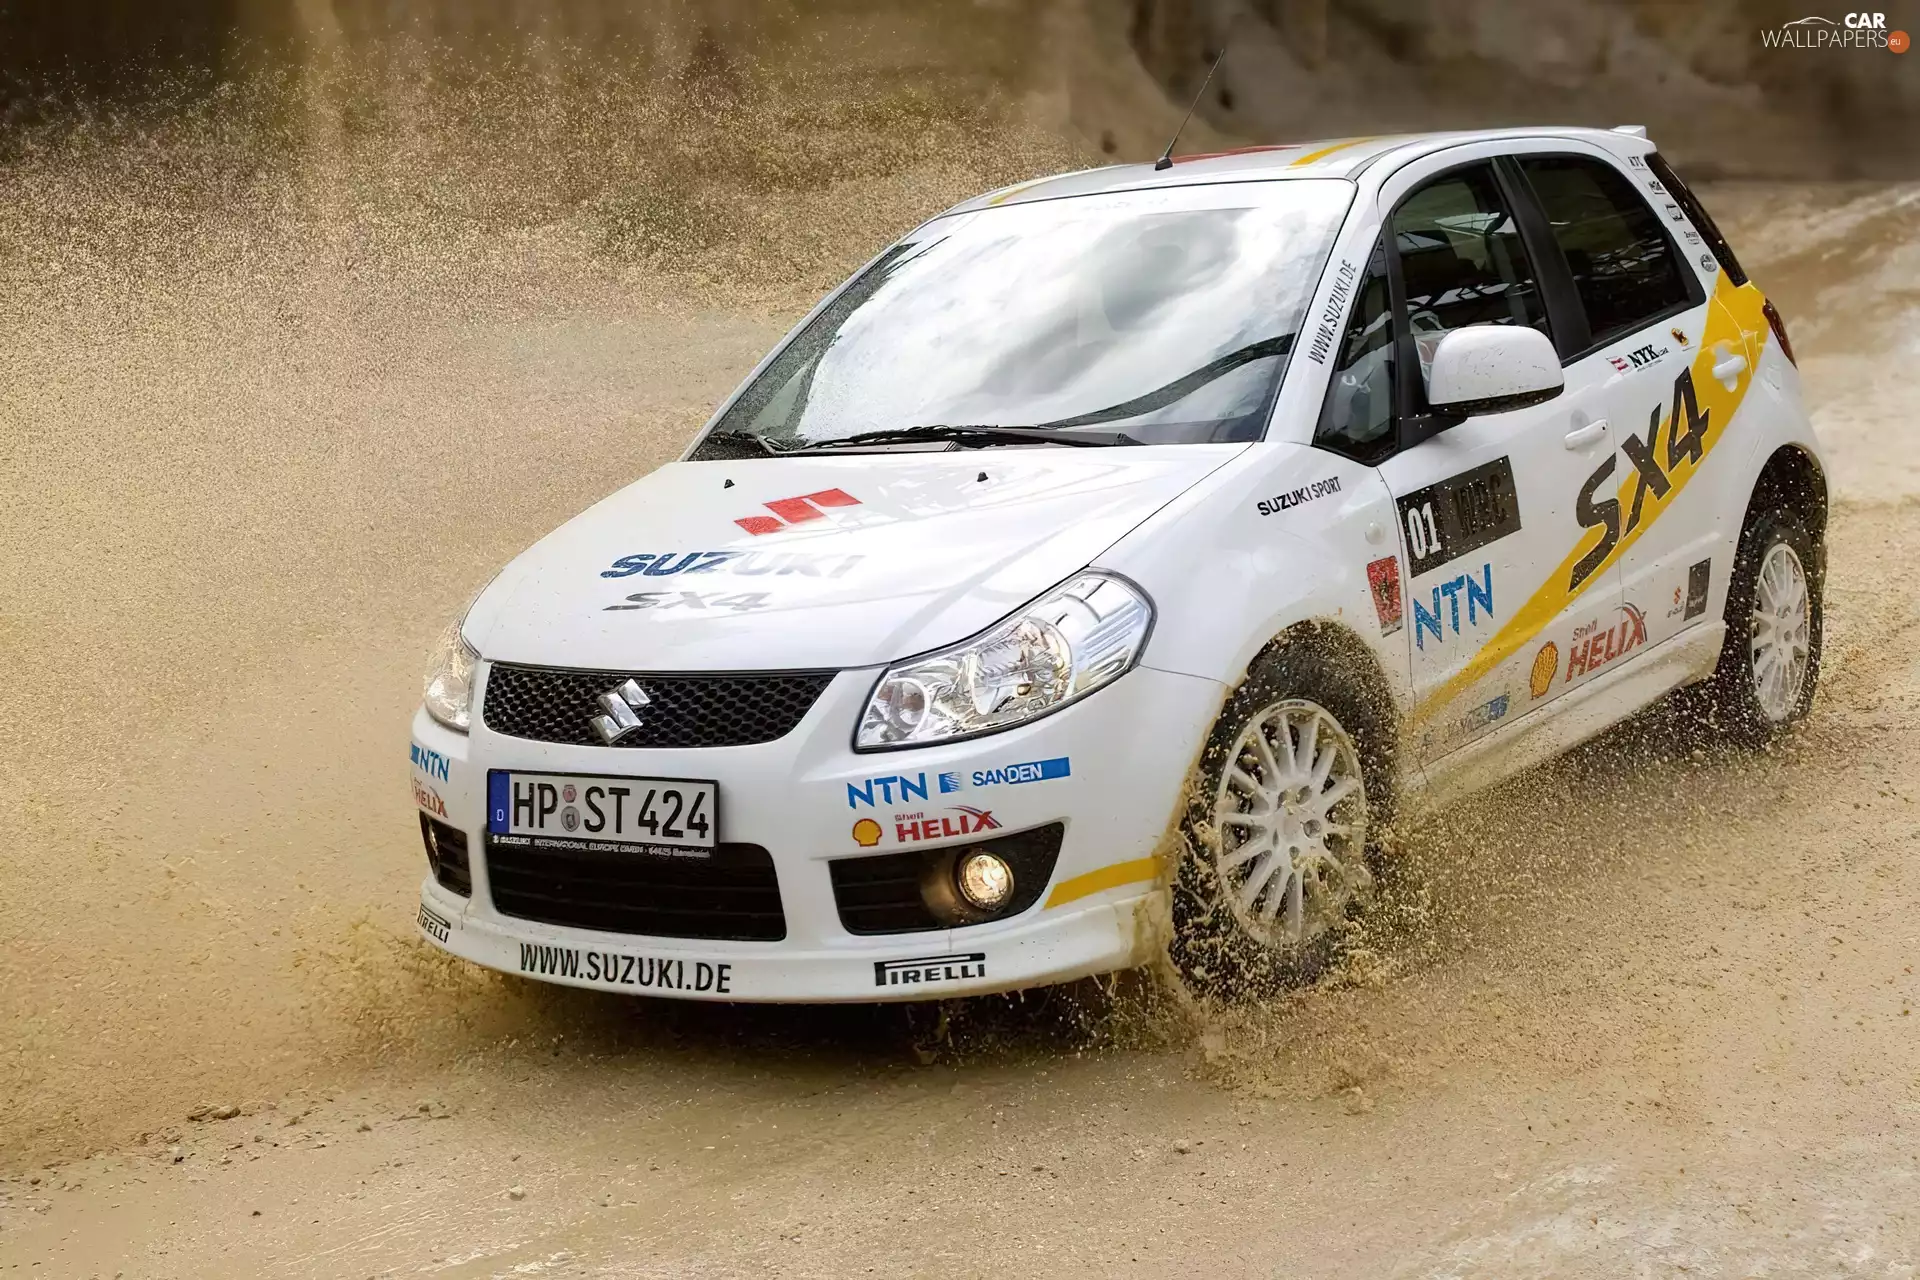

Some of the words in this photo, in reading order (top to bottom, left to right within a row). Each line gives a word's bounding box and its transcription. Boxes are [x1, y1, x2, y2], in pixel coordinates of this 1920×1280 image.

[1307, 258, 1357, 365] WWW.SUZUKI.DE
[1257, 485, 1313, 517] SUZUKI
[1313, 476, 1342, 500] SPORT
[1568, 366, 1709, 593] SX4
[1407, 501, 1442, 560] 01
[600, 551, 866, 579] SUZUKI
[602, 591, 772, 612] SX4
[1413, 563, 1493, 652] NTN
[1565, 610, 1648, 684] HELIX
[419, 747, 451, 784] NTN
[972, 763, 1043, 787] SANDEN
[513, 782, 558, 830] HP
[584, 786, 631, 834] ST
[637, 789, 710, 840] 424
[847, 772, 928, 810] NTN
[496, 809, 504, 822] D
[895, 810, 1001, 843] HELIX
[417, 902, 452, 944] PIRELLI
[519, 942, 732, 994] WWW.SUZUKI.DE
[873, 952, 986, 987] PIRELLI
